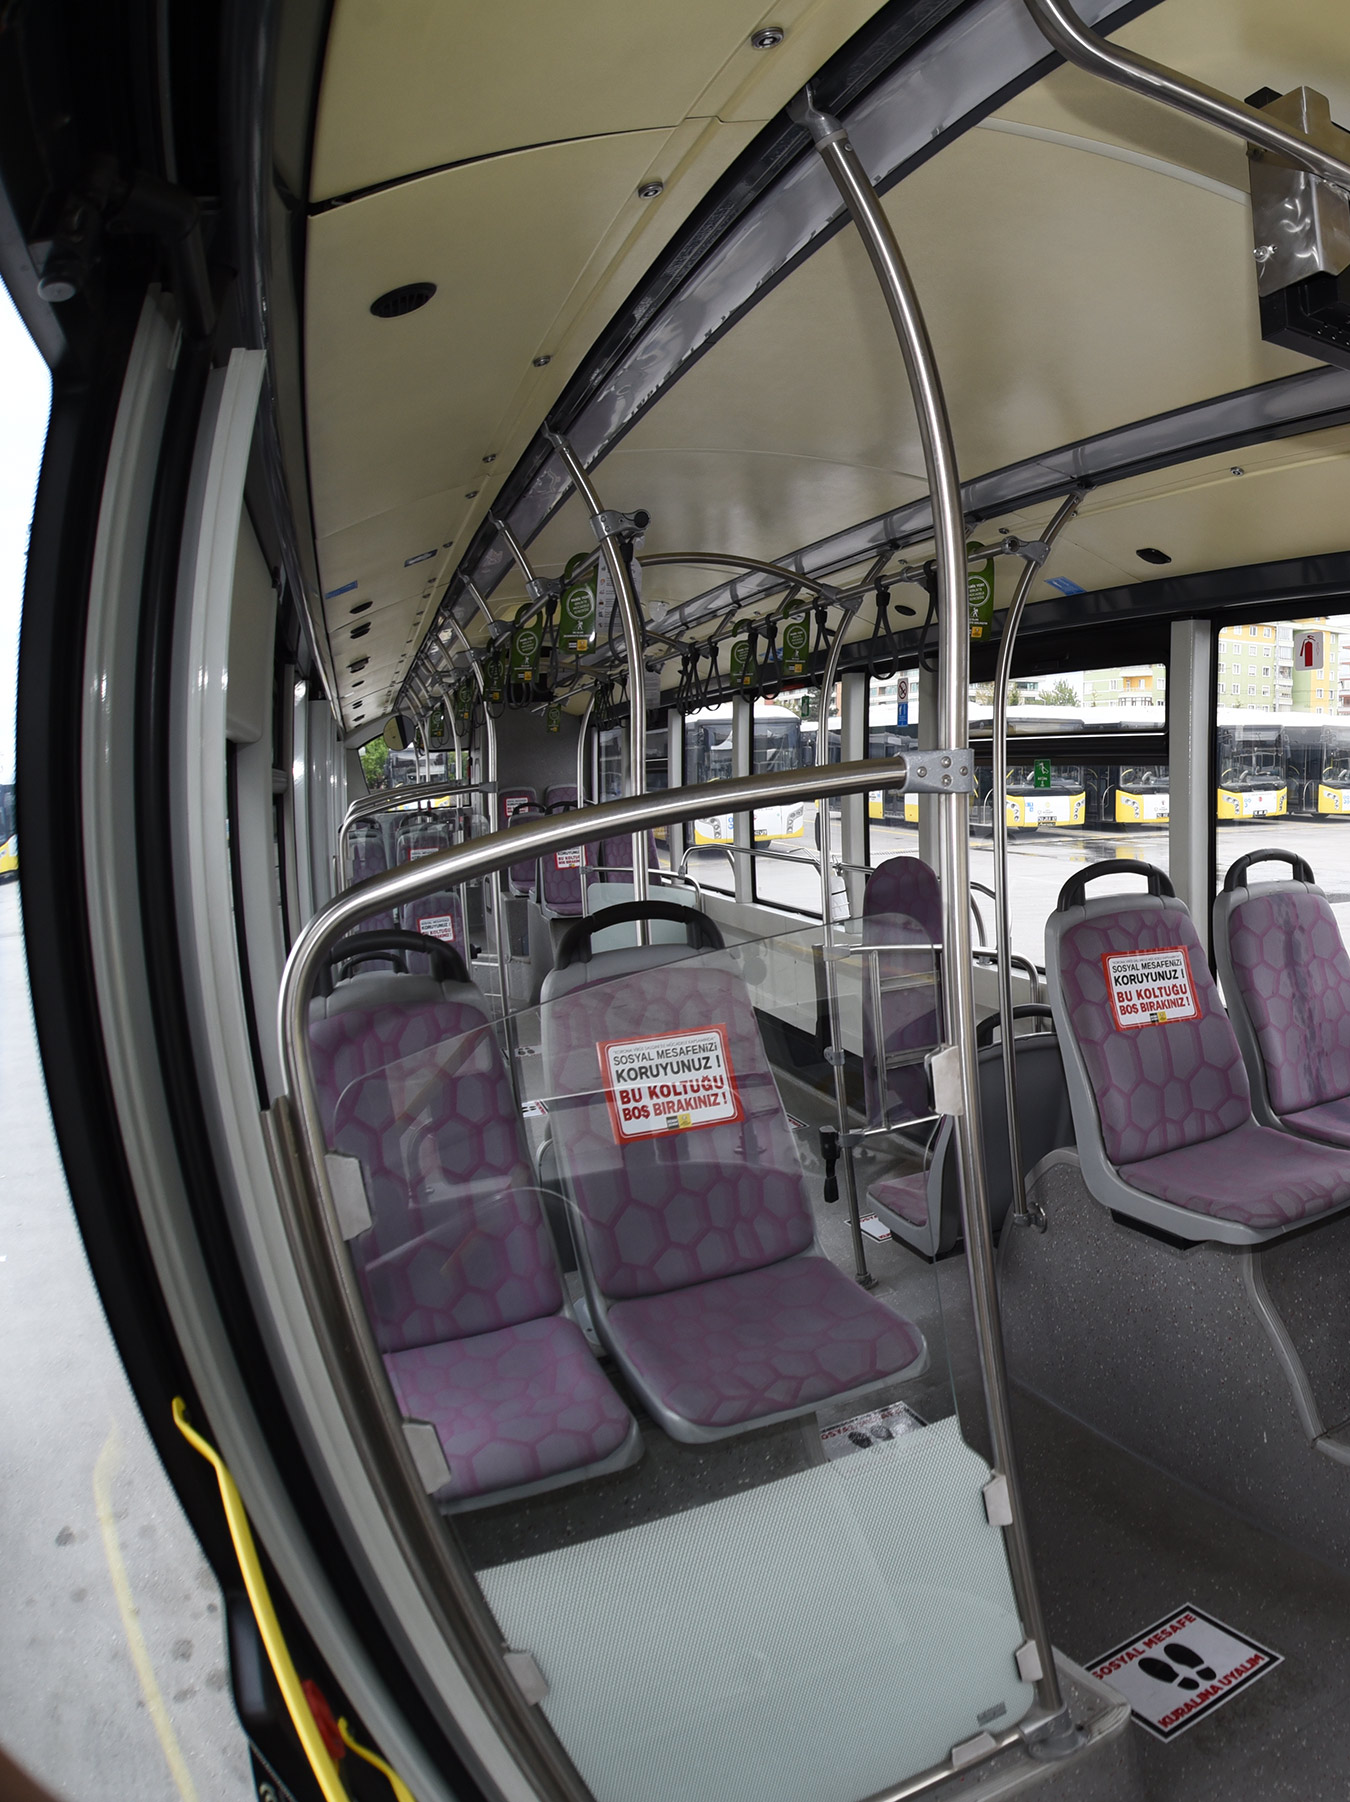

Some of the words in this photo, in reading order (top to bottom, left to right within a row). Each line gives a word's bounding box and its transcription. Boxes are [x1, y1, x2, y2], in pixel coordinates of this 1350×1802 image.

[1112, 962, 1140, 973] SOSYAL
[1114, 969, 1179, 986] KORUYUNUZ
[1116, 990, 1133, 1003] BU
[1136, 983, 1188, 1001] KOLTUĞU
[1119, 1003, 1139, 1015] BOŞ
[1140, 997, 1186, 1013] BIRAKINIZ
[613, 1051, 654, 1066] SOSYAL
[616, 1056, 712, 1083] KORUYUNUZ
[619, 1088, 642, 1105] BU
[647, 1075, 725, 1101] KOLTUĞU
[622, 1105, 650, 1121] BOŞ
[652, 1092, 721, 1117] BIRAKINIZ
[1142, 1613, 1196, 1649] MESAFE
[1158, 1683, 1223, 1728] KURALINA
[1219, 1653, 1265, 1687] UYALIM
